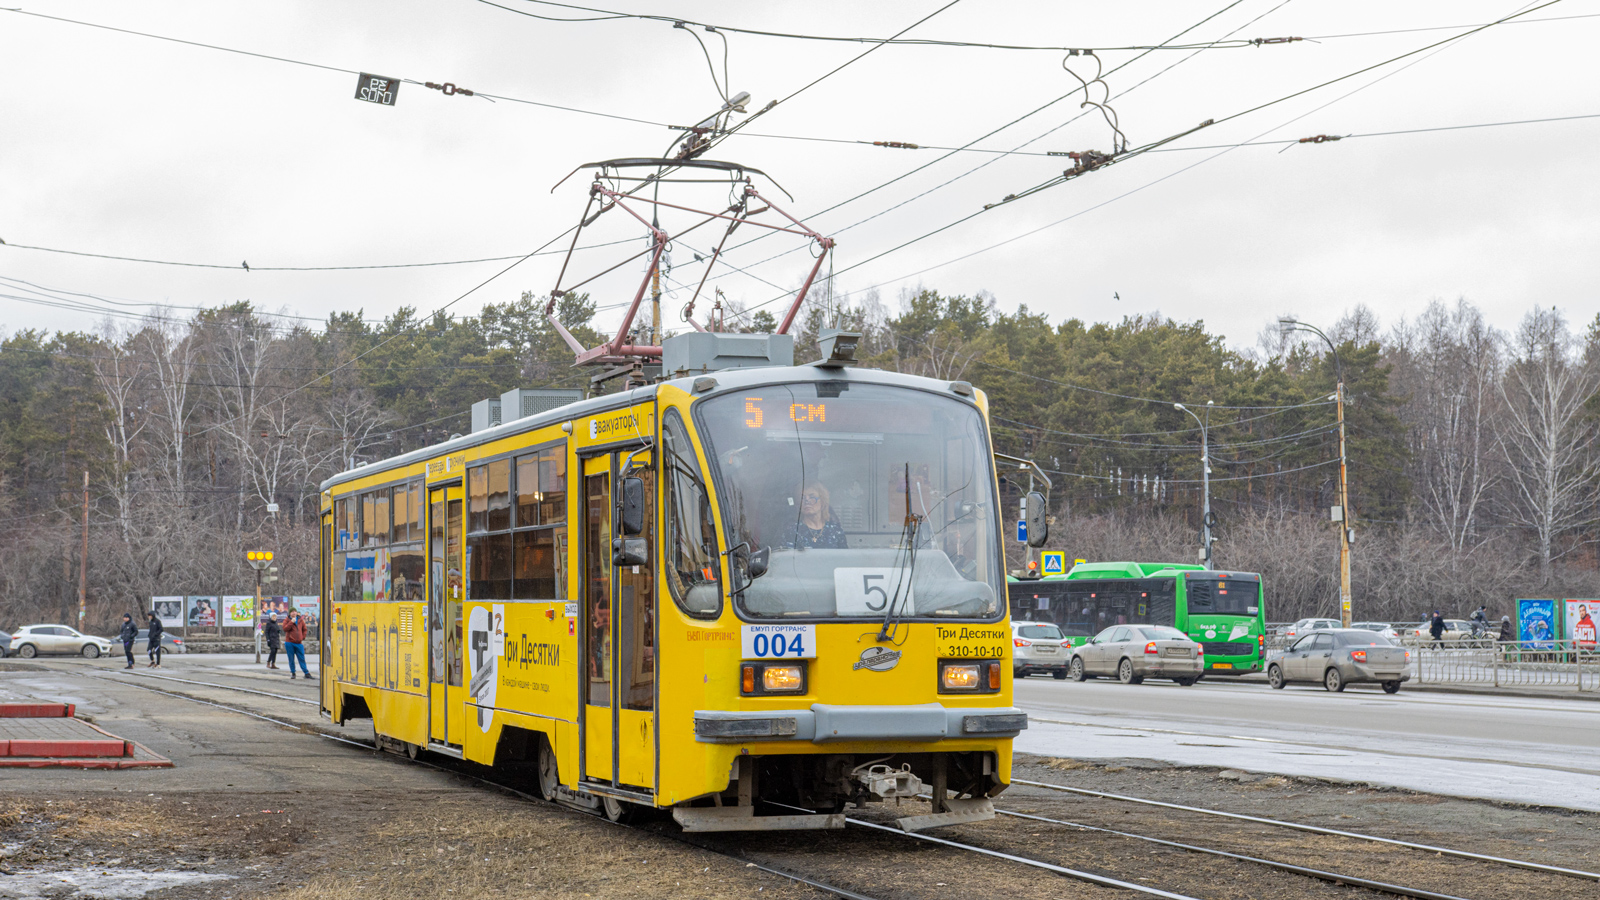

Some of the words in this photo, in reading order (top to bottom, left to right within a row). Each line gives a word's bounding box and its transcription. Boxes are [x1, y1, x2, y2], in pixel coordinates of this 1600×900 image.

[594, 413, 639, 435] эвакуаторы
[745, 397, 763, 428] 5
[863, 575, 888, 611] 5
[753, 633, 805, 657] 004
[936, 627, 956, 640] Три
[959, 627, 1005, 640] Десятки
[504, 632, 518, 668] Три
[520, 633, 560, 670] Десятки
[948, 645, 1003, 657] 310-10-10
